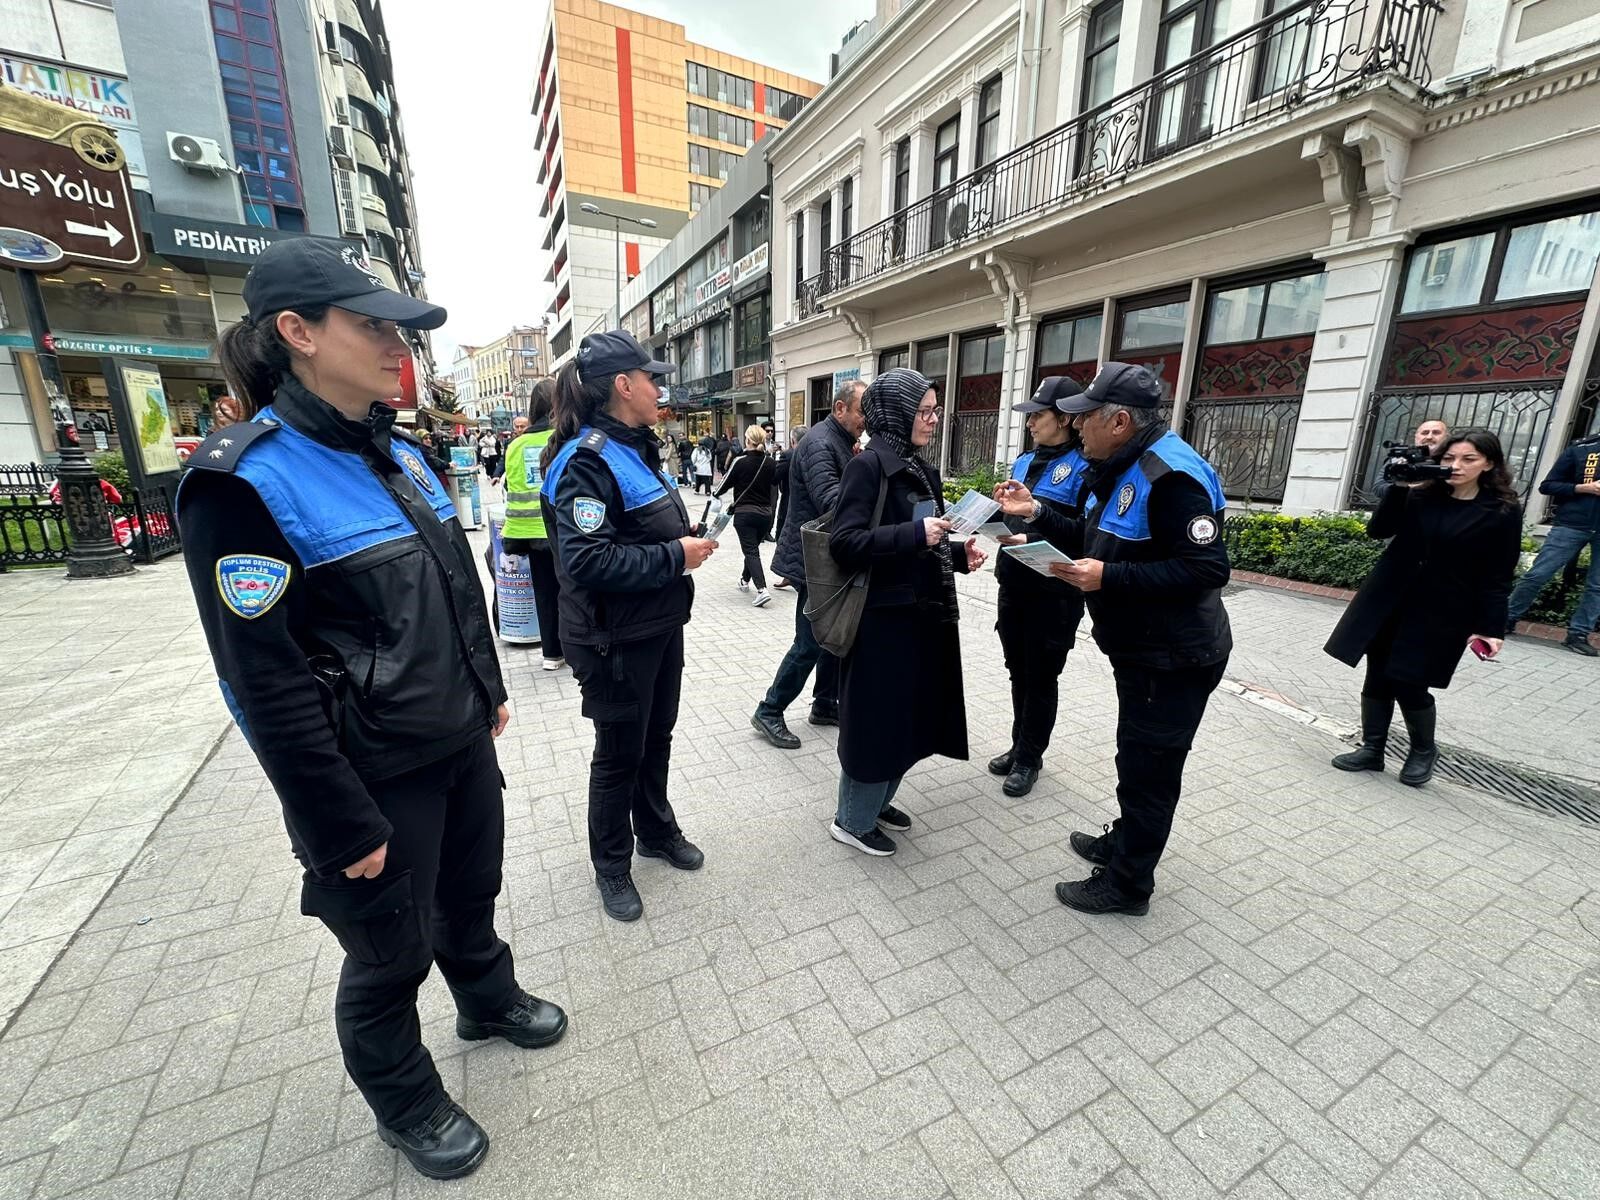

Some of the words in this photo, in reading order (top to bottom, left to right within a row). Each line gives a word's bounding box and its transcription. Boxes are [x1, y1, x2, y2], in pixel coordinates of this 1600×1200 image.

[0, 58, 127, 105] İATRİK
[40, 168, 115, 209] Yolu
[223, 559, 252, 567] TOPLUM
[253, 559, 285, 571] DESTEKLİ
[239, 566, 269, 574] POLİS
